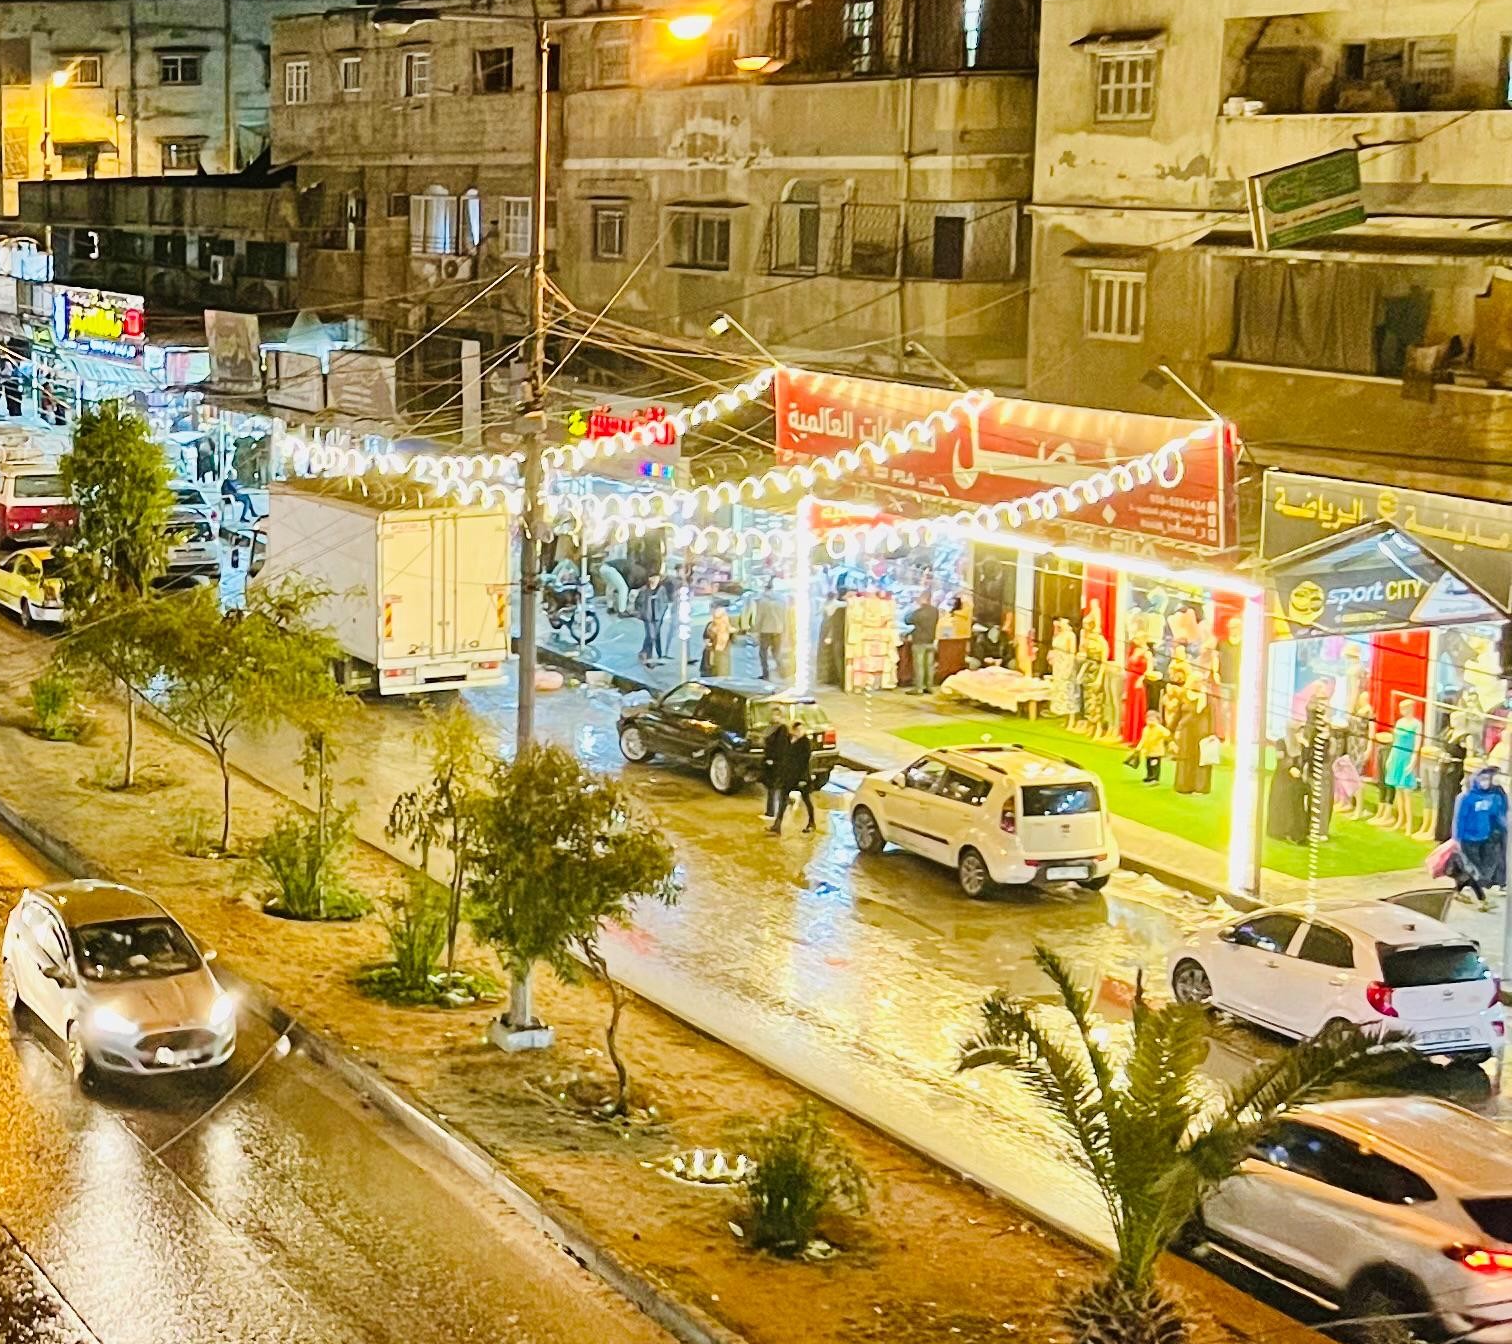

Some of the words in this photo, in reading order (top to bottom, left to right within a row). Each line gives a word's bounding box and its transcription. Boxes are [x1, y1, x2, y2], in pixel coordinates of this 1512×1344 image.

[787, 402, 854, 440] العالمية
[1273, 485, 1366, 530] الرياضة
[1403, 505, 1511, 552] مدينة
[1326, 580, 1385, 612] sport
[1385, 578, 1423, 602] CITY
